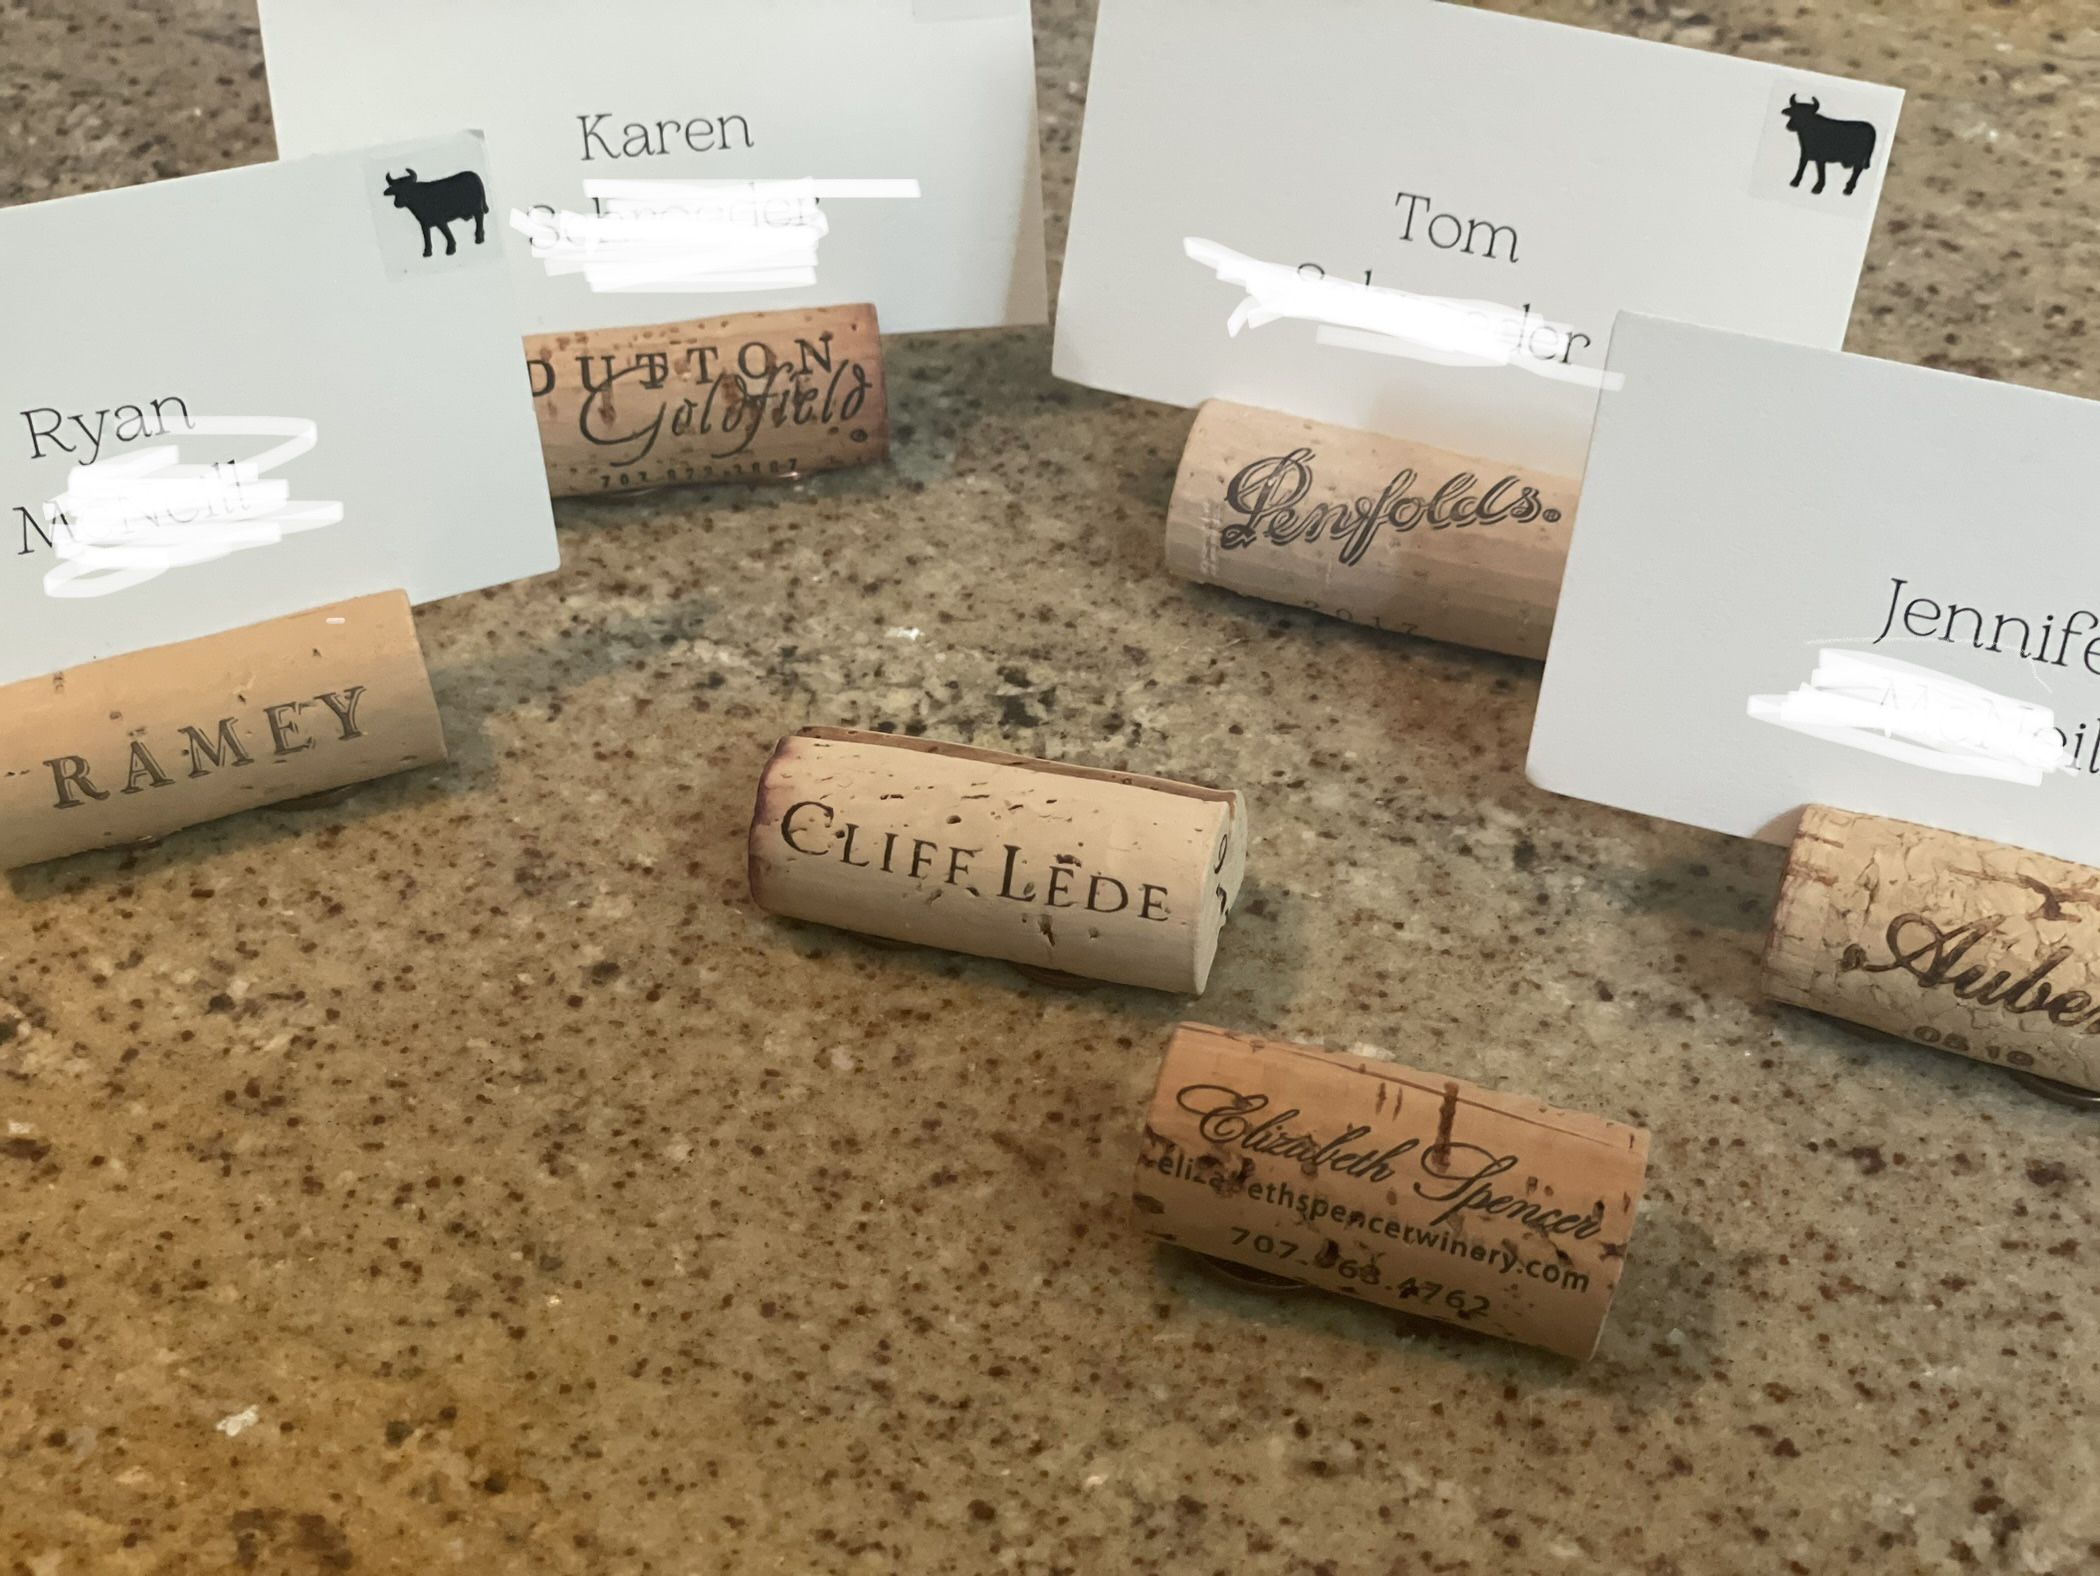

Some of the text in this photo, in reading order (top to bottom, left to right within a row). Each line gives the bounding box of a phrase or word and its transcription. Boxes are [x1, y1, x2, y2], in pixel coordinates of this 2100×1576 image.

[576, 112, 755, 162] Karen
[1395, 191, 1520, 263] Tom
[527, 331, 834, 398] DUTTON
[20, 395, 196, 466] Ryan
[579, 359, 873, 467] Goldfield
[43, 684, 367, 809] RAMEY
[1176, 1084, 1602, 1240] Elizabeth Spencer
[1157, 1151, 1590, 1294] elizaethspencerwinery.com
[1230, 1227, 1491, 1319] 707.63.4762
